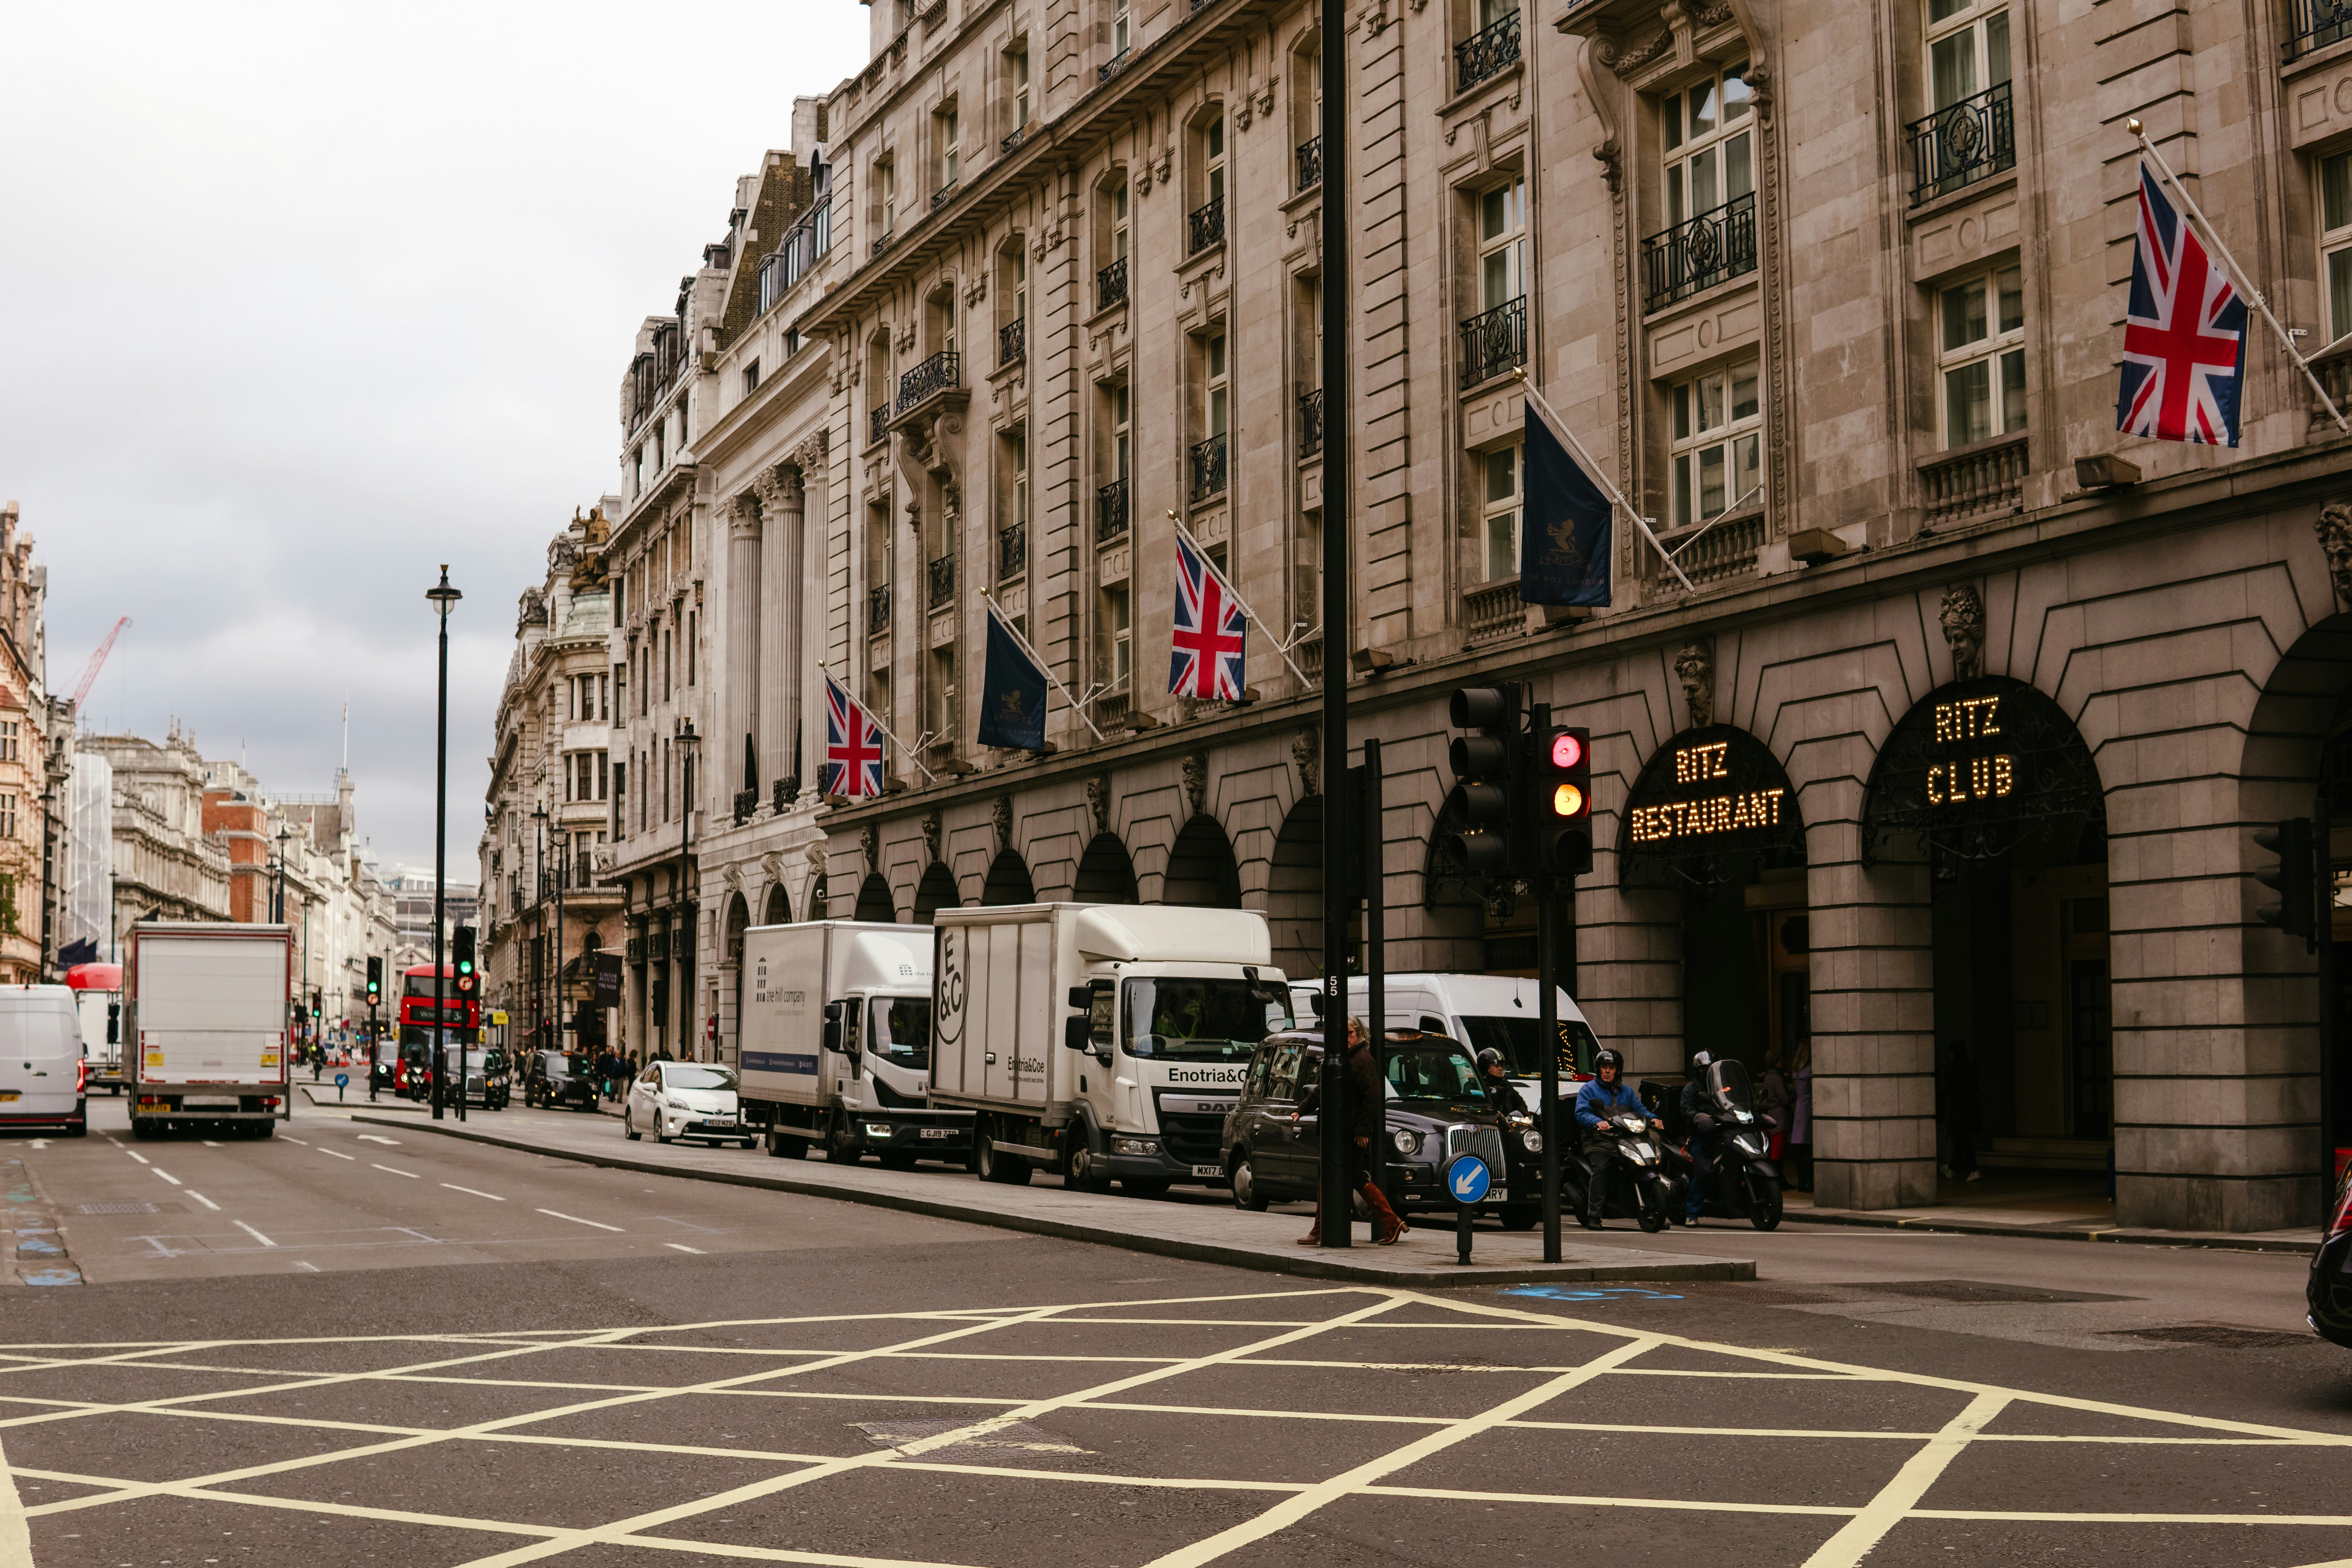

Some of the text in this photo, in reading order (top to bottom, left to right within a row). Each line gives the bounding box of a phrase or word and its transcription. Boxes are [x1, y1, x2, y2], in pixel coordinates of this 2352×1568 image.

[1936, 694, 2000, 743] RITZ
[1677, 741, 1727, 784] RITZ
[1928, 754, 2013, 806] CLUB
[1632, 788, 1784, 842] RESTAURANT
[945, 932, 954, 977] E
[784, 991, 805, 1007] company
[1008, 1057, 1044, 1073] Enotria&Coe
[1169, 1068, 1247, 1083] Enotria&C
[1198, 1166, 1217, 1175] MX17
